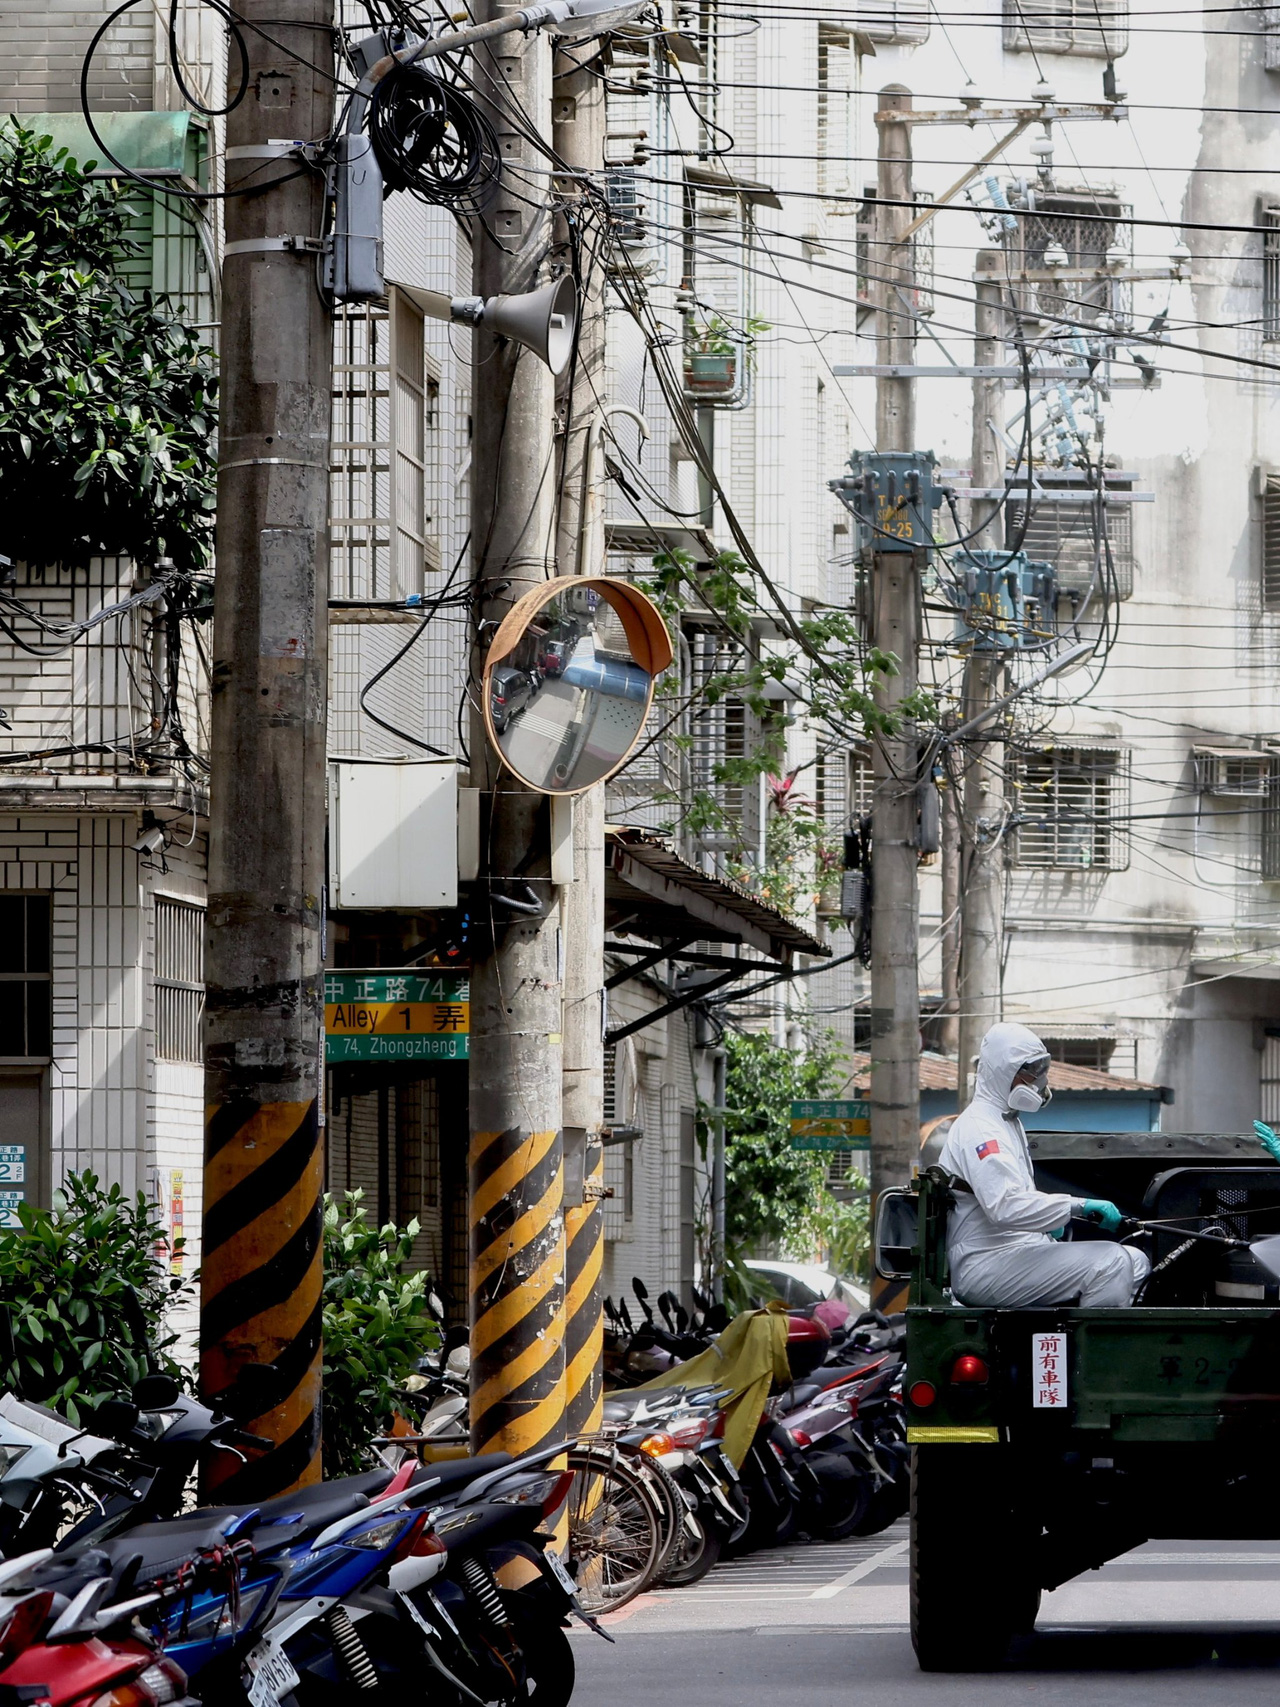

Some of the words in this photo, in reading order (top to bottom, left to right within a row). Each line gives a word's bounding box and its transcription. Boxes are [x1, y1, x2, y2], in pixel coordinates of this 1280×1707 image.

[333, 1005, 379, 1034] Alley
[399, 1008, 411, 1030] 1
[433, 1005, 465, 1031] 弄
[324, 1041, 335, 1054] n.
[344, 1038, 362, 1056] 74,
[370, 1037, 457, 1057] Zhongzheng
[1038, 1335, 1062, 1406] 前有車隊
[258, 1650, 295, 1692] 8V-615
